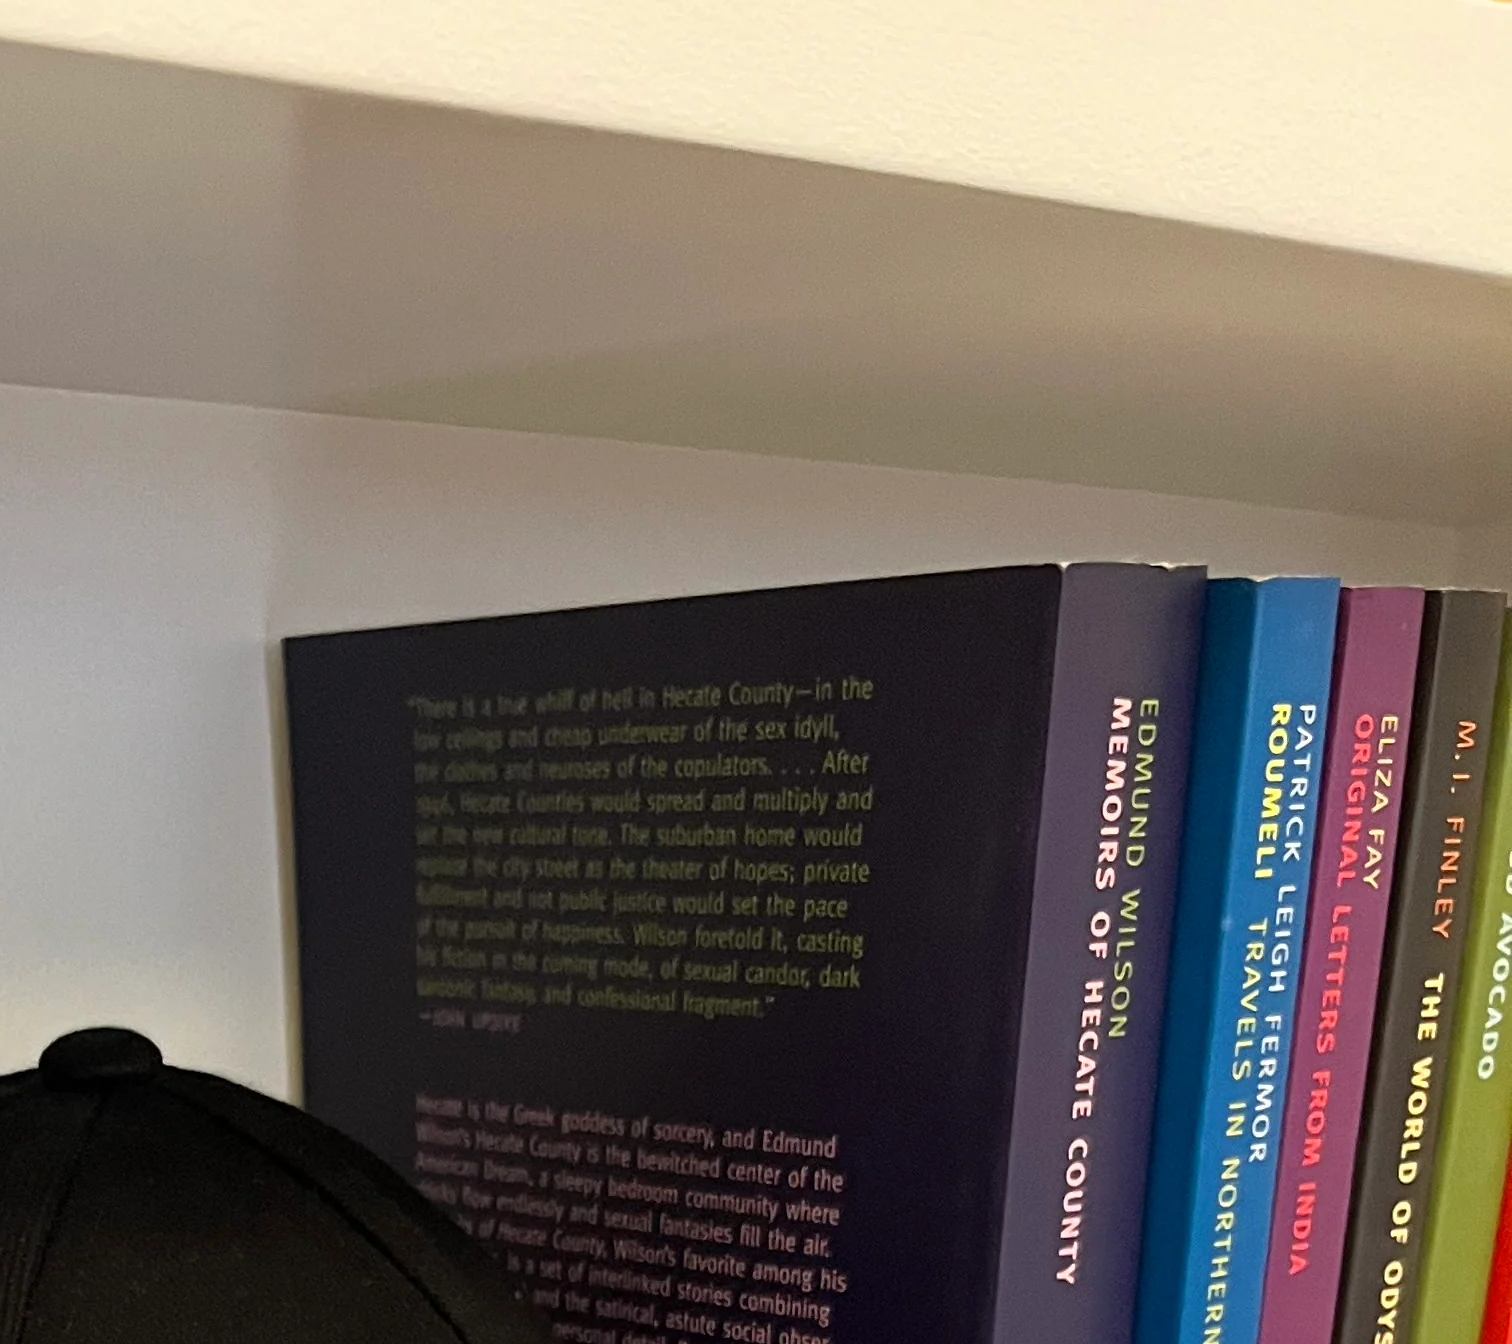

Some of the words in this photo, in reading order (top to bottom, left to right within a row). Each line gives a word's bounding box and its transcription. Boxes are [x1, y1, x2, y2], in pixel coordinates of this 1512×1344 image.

[841, 675, 873, 701] the
[755, 720, 786, 742] sex
[794, 716, 839, 741] idyll,
[1454, 720, 1478, 763] M.
[822, 751, 869, 775] After
[1094, 697, 1133, 891] MEMOIRS
[1125, 699, 1159, 868] EDMUND
[1254, 703, 1292, 881] ROUMELI
[1283, 704, 1316, 863] PATRICK
[1368, 715, 1398, 814] ELIZA
[753, 788, 829, 815] multiply
[836, 786, 873, 812] and
[1335, 713, 1375, 887] ORIGINAL
[657, 824, 737, 848] suburban
[744, 824, 795, 848] home
[804, 823, 863, 848] would
[1362, 828, 1386, 890] FAY
[804, 861, 870, 884] private
[1431, 815, 1465, 938] FINLEY
[766, 894, 795, 917] the
[804, 899, 848, 922] pace
[1090, 911, 1112, 961] OF
[797, 930, 864, 959] casting
[1108, 888, 1141, 1039] WILSON
[1268, 885, 1297, 994] LEIGH
[684, 959, 738, 983] sexual
[819, 965, 860, 988] dark
[1231, 919, 1267, 1081] TRAVELS
[1315, 904, 1352, 1055] LETTERS
[1478, 911, 1512, 1081] AVOCADO
[1416, 972, 1445, 1041] THE
[1071, 981, 1105, 1119] HECATE
[1248, 1015, 1282, 1163] FERMOR
[1301, 1069, 1331, 1168] FROM
[653, 1120, 714, 1148] sorcery,
[762, 1129, 836, 1158] Edmund
[1225, 1103, 1244, 1138] IN
[1395, 1057, 1433, 1185] WORLD
[685, 1188, 778, 1222] community
[786, 1199, 840, 1225] where
[727, 1161, 780, 1186] center
[788, 1165, 808, 1189] of
[814, 1168, 844, 1193] the
[659, 1212, 733, 1245] fantasies
[768, 1225, 796, 1252] the
[1055, 1138, 1088, 1286] COUNTY
[1288, 1182, 1314, 1277] INDIA
[1389, 1200, 1412, 1245] OF
[752, 1263, 812, 1292] among
[820, 1268, 847, 1292] his
[739, 1291, 831, 1327] combining
